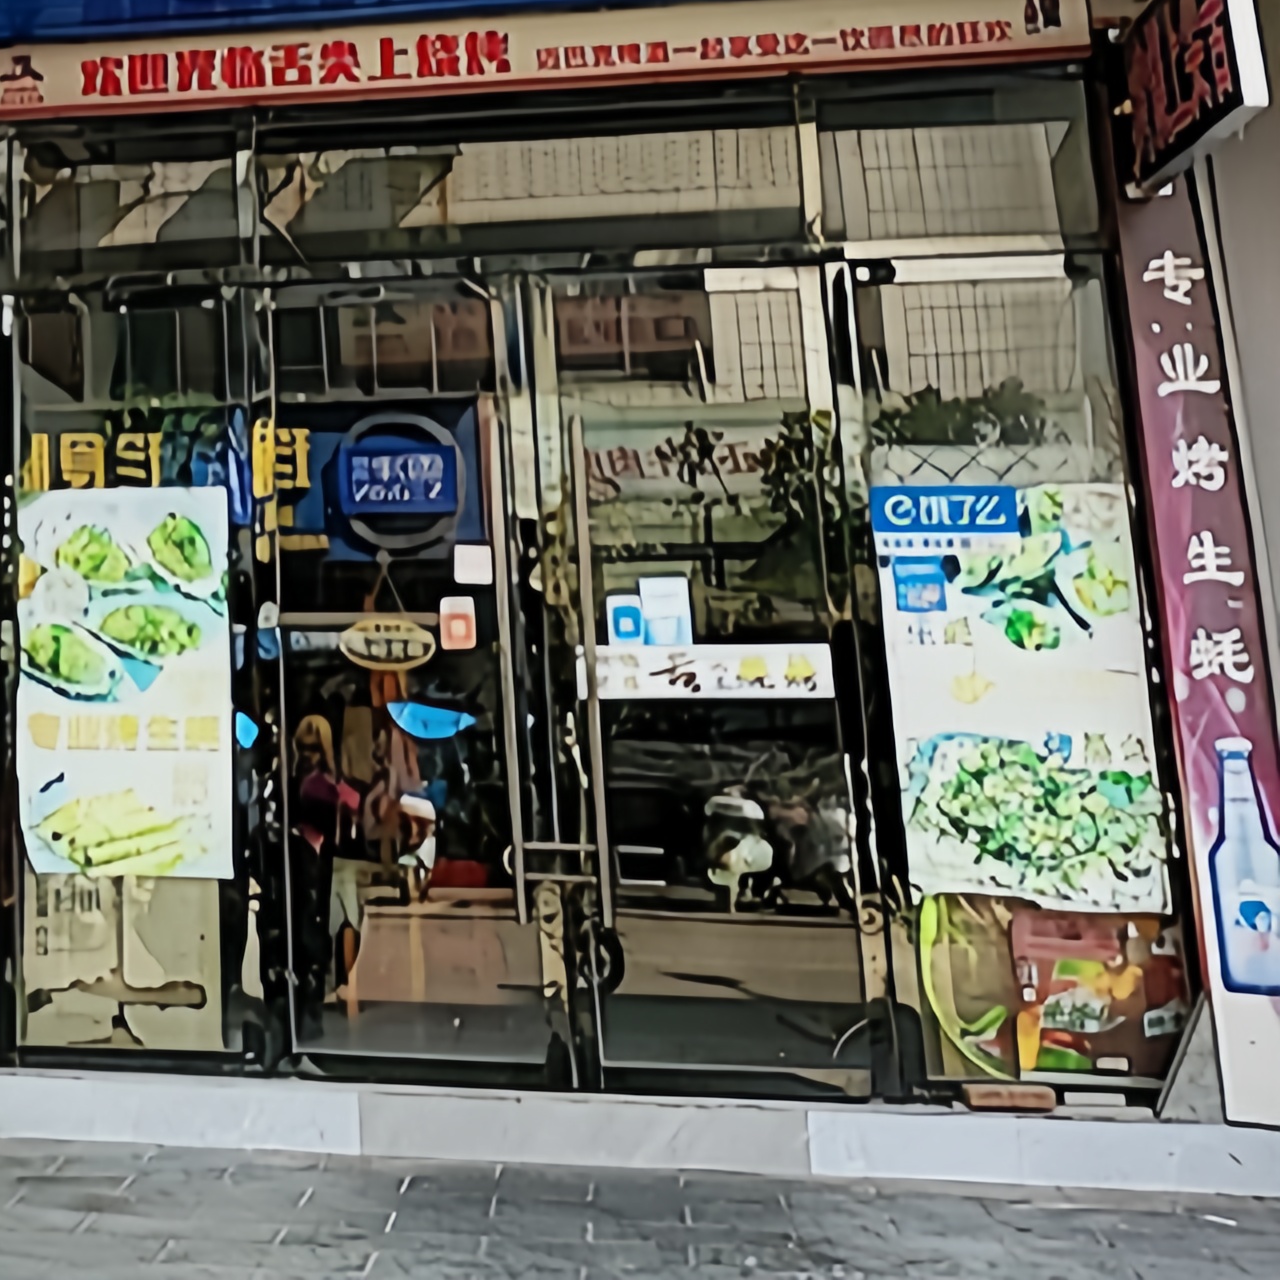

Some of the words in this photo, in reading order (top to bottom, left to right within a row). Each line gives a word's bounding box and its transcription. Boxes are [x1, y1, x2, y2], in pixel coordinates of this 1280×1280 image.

[1142, 249, 1255, 684] 专业烤生蚝
